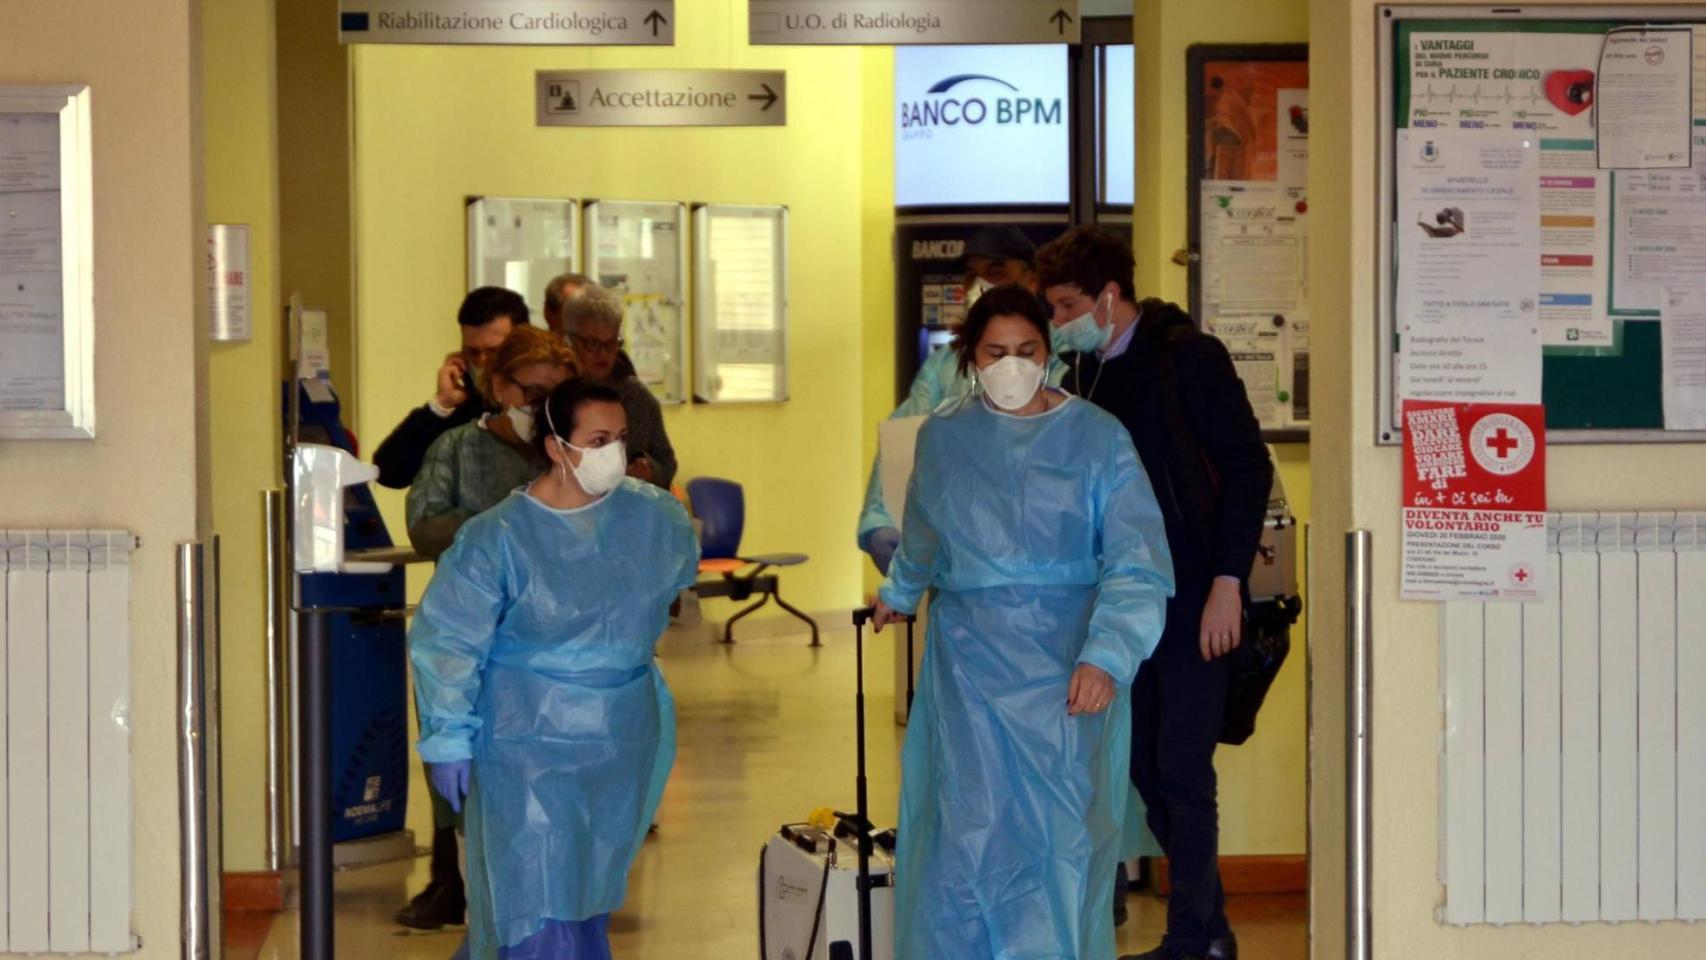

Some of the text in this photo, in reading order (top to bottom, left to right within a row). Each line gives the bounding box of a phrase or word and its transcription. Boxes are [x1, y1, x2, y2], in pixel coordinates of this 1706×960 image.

[377, 11, 629, 34] Riabilitazione Cardiologica
[785, 12, 942, 33] U.O. di Radiologia
[1420, 40, 1475, 50] VANTAGGI
[1439, 68, 1490, 79] PAZIENTE
[589, 86, 737, 108] Accettazione
[902, 98, 1062, 128] BANCO BPM
[1413, 119, 1438, 128] MENO
[1459, 119, 1485, 128] MENO
[1512, 121, 1537, 129] MENO
[1408, 412, 1457, 426] AMARE
[1411, 427, 1461, 442] DARE
[1414, 443, 1464, 455] GIOCARE
[1415, 450, 1465, 465] VOLARE
[1417, 465, 1467, 481] FARE
[1431, 478, 1448, 490] di
[1414, 490, 1432, 506] in
[1470, 491, 1492, 506] sei
[1493, 489, 1515, 504] tu
[1406, 509, 1544, 523] DIVENTA ANCHE TU
[1406, 520, 1500, 532] VOLONTARIO
[1449, 532, 1488, 540] FEBBRAIO
[1489, 533, 1506, 541] 2020
[1406, 541, 1461, 549] PRESENTAZIONE
